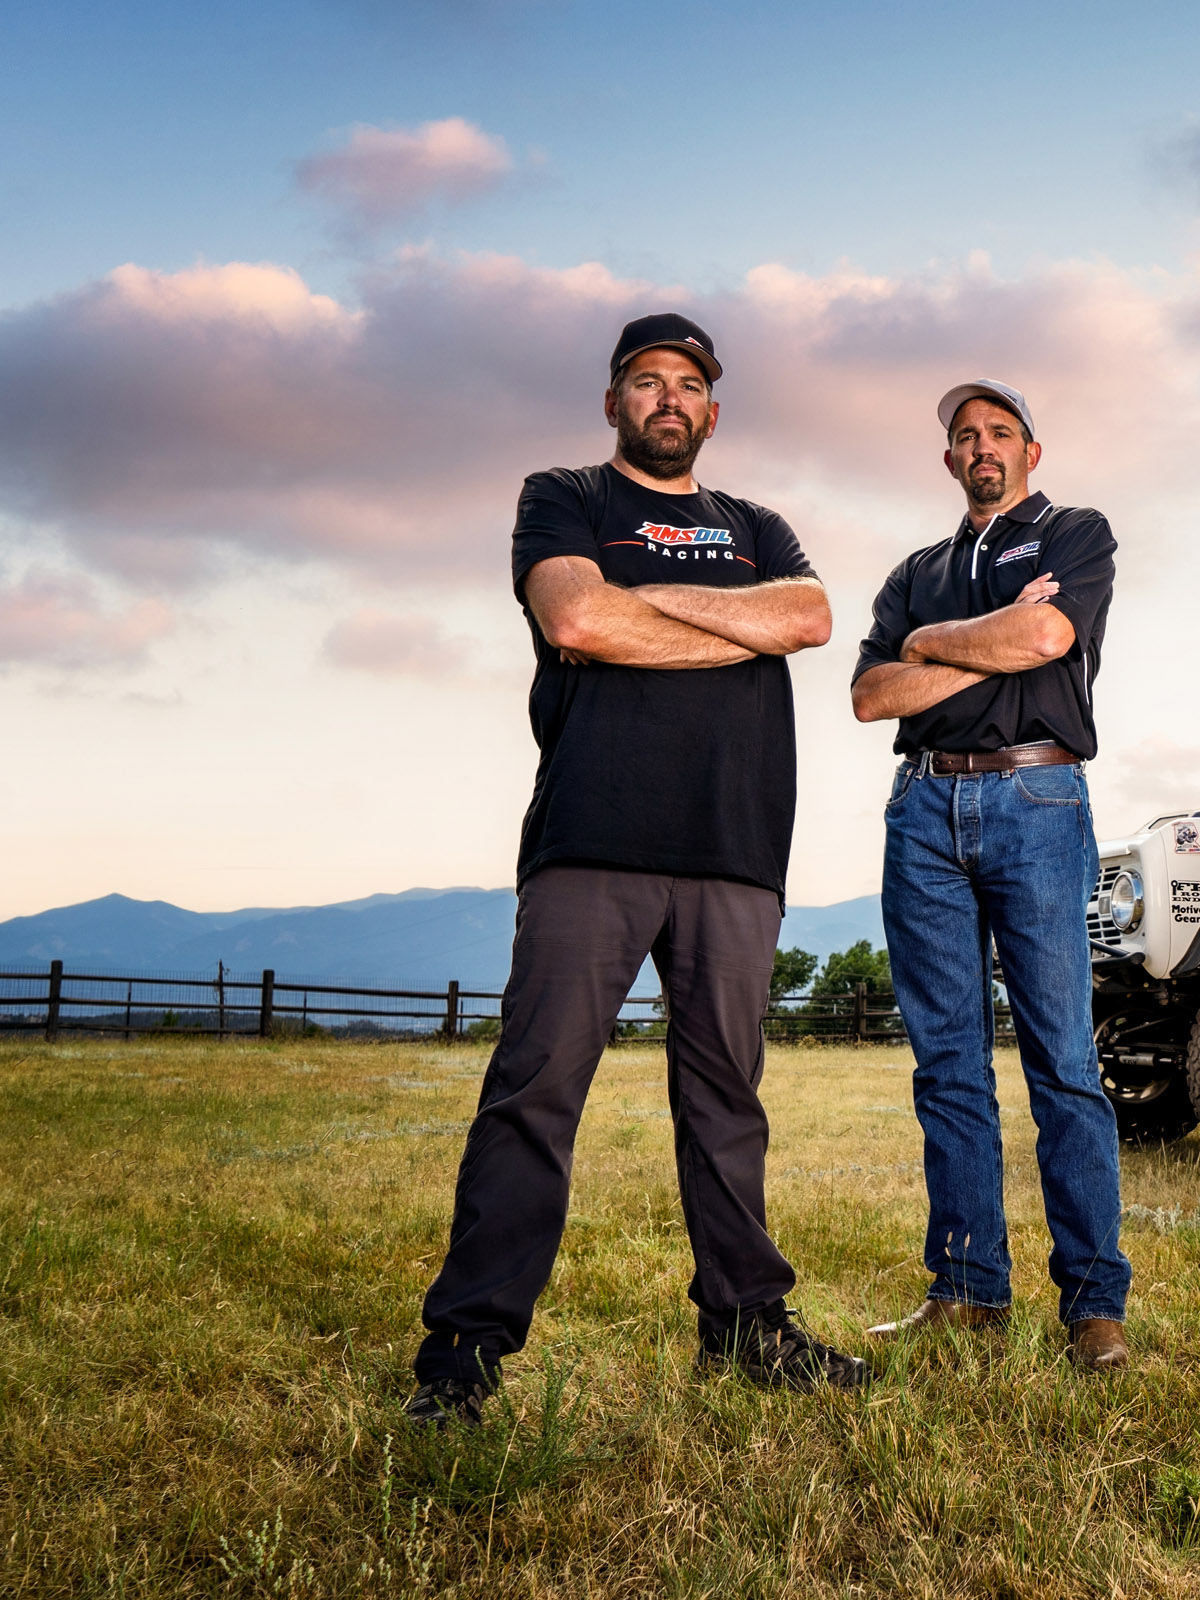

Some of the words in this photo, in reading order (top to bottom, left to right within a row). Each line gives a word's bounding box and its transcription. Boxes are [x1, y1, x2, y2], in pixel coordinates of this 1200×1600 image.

[641, 523, 731, 545] AMSOIL
[647, 542, 734, 560] RACING
[1174, 914, 1200, 923] Gear
